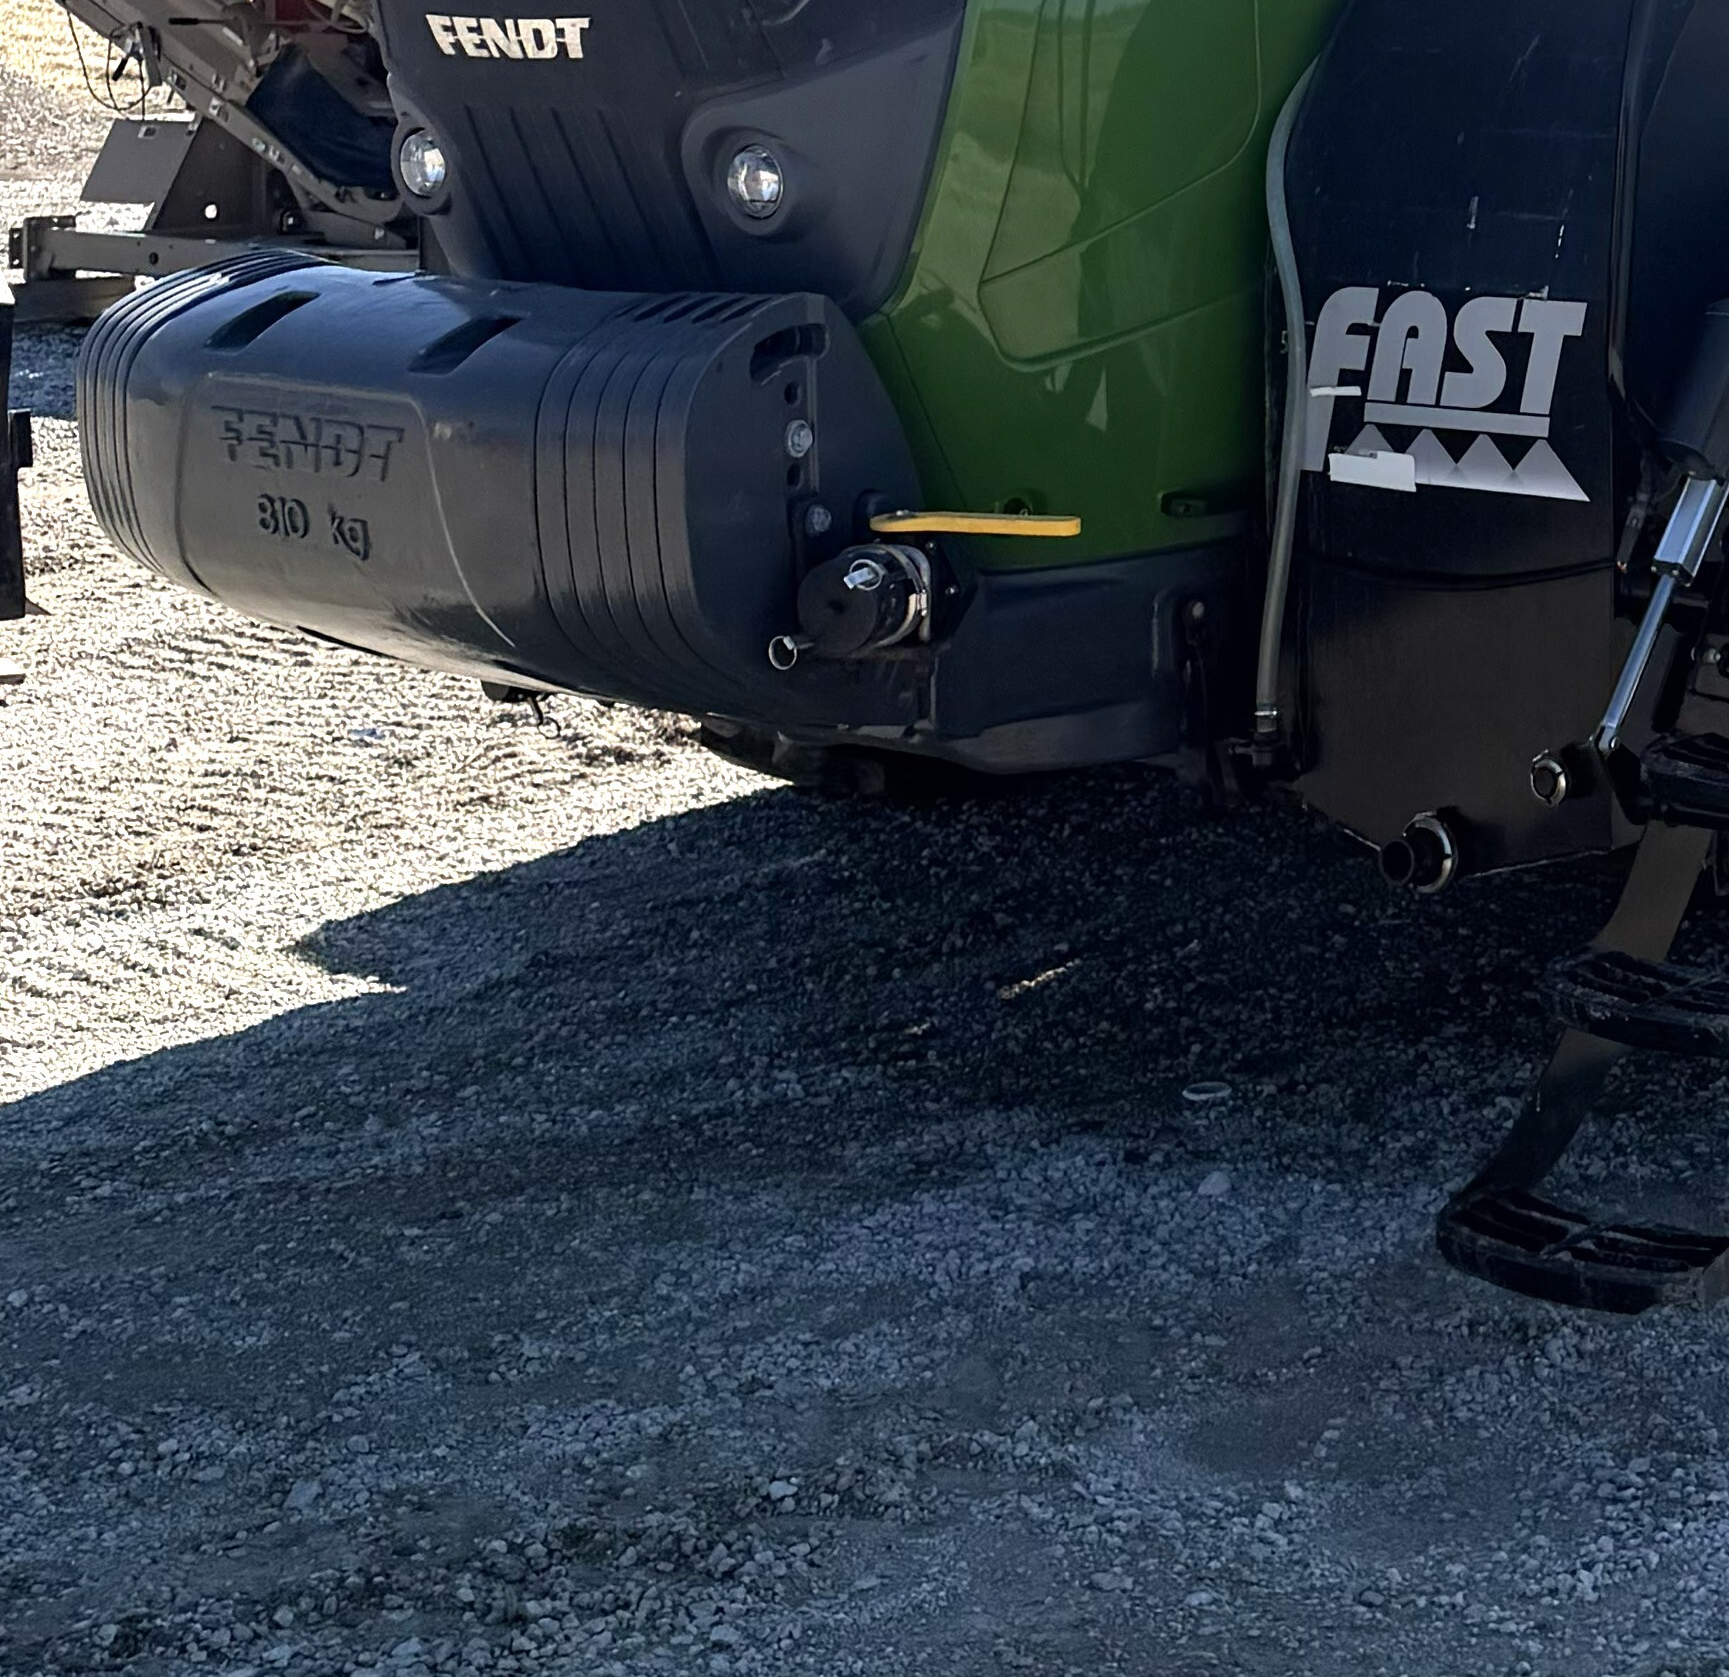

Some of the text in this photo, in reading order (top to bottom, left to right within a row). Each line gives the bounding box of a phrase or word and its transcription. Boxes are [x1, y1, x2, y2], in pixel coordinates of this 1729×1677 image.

[425, 14, 591, 59] FENDT
[1300, 287, 1587, 472] FAST
[211, 405, 404, 482] FENDT
[328, 503, 372, 561] kg
